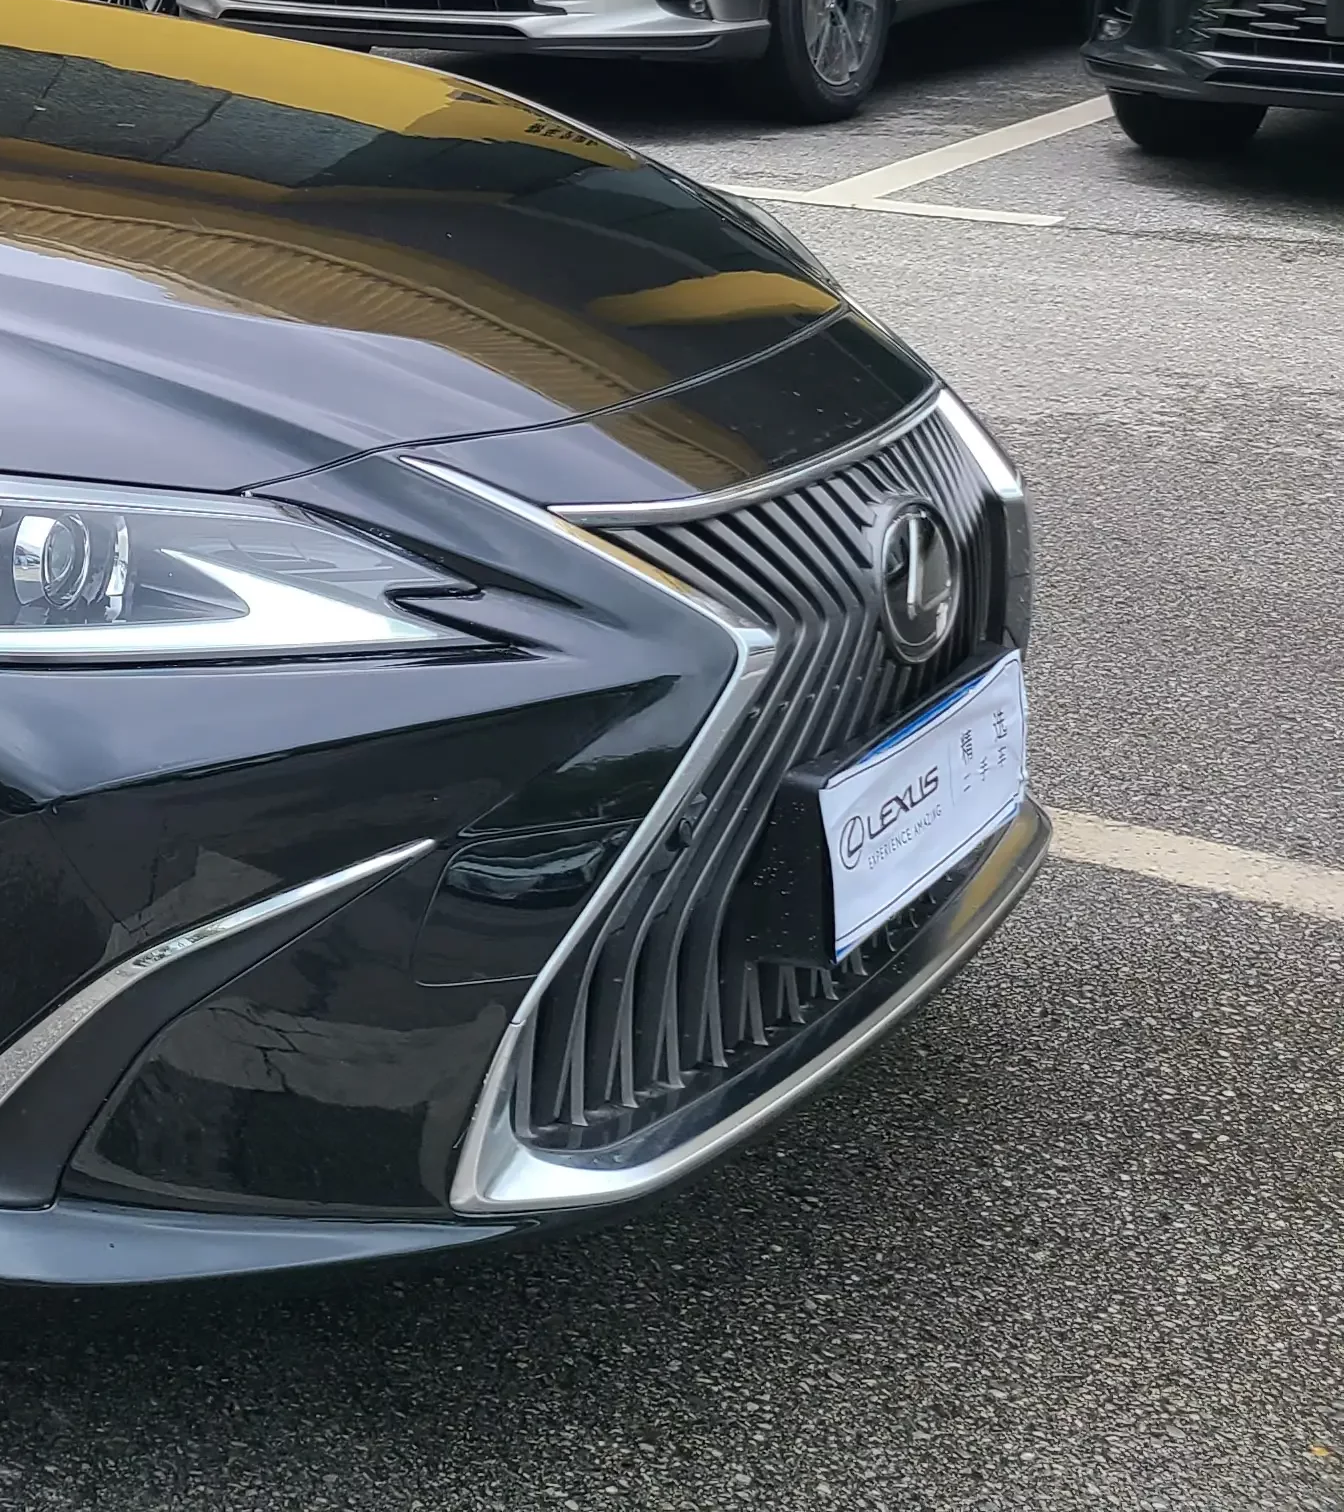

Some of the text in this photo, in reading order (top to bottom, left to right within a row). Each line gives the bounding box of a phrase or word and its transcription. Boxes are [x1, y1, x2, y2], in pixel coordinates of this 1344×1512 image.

[867, 765, 939, 840] LEXUS
[868, 803, 943, 870] EXPERIENCE AMAZING
